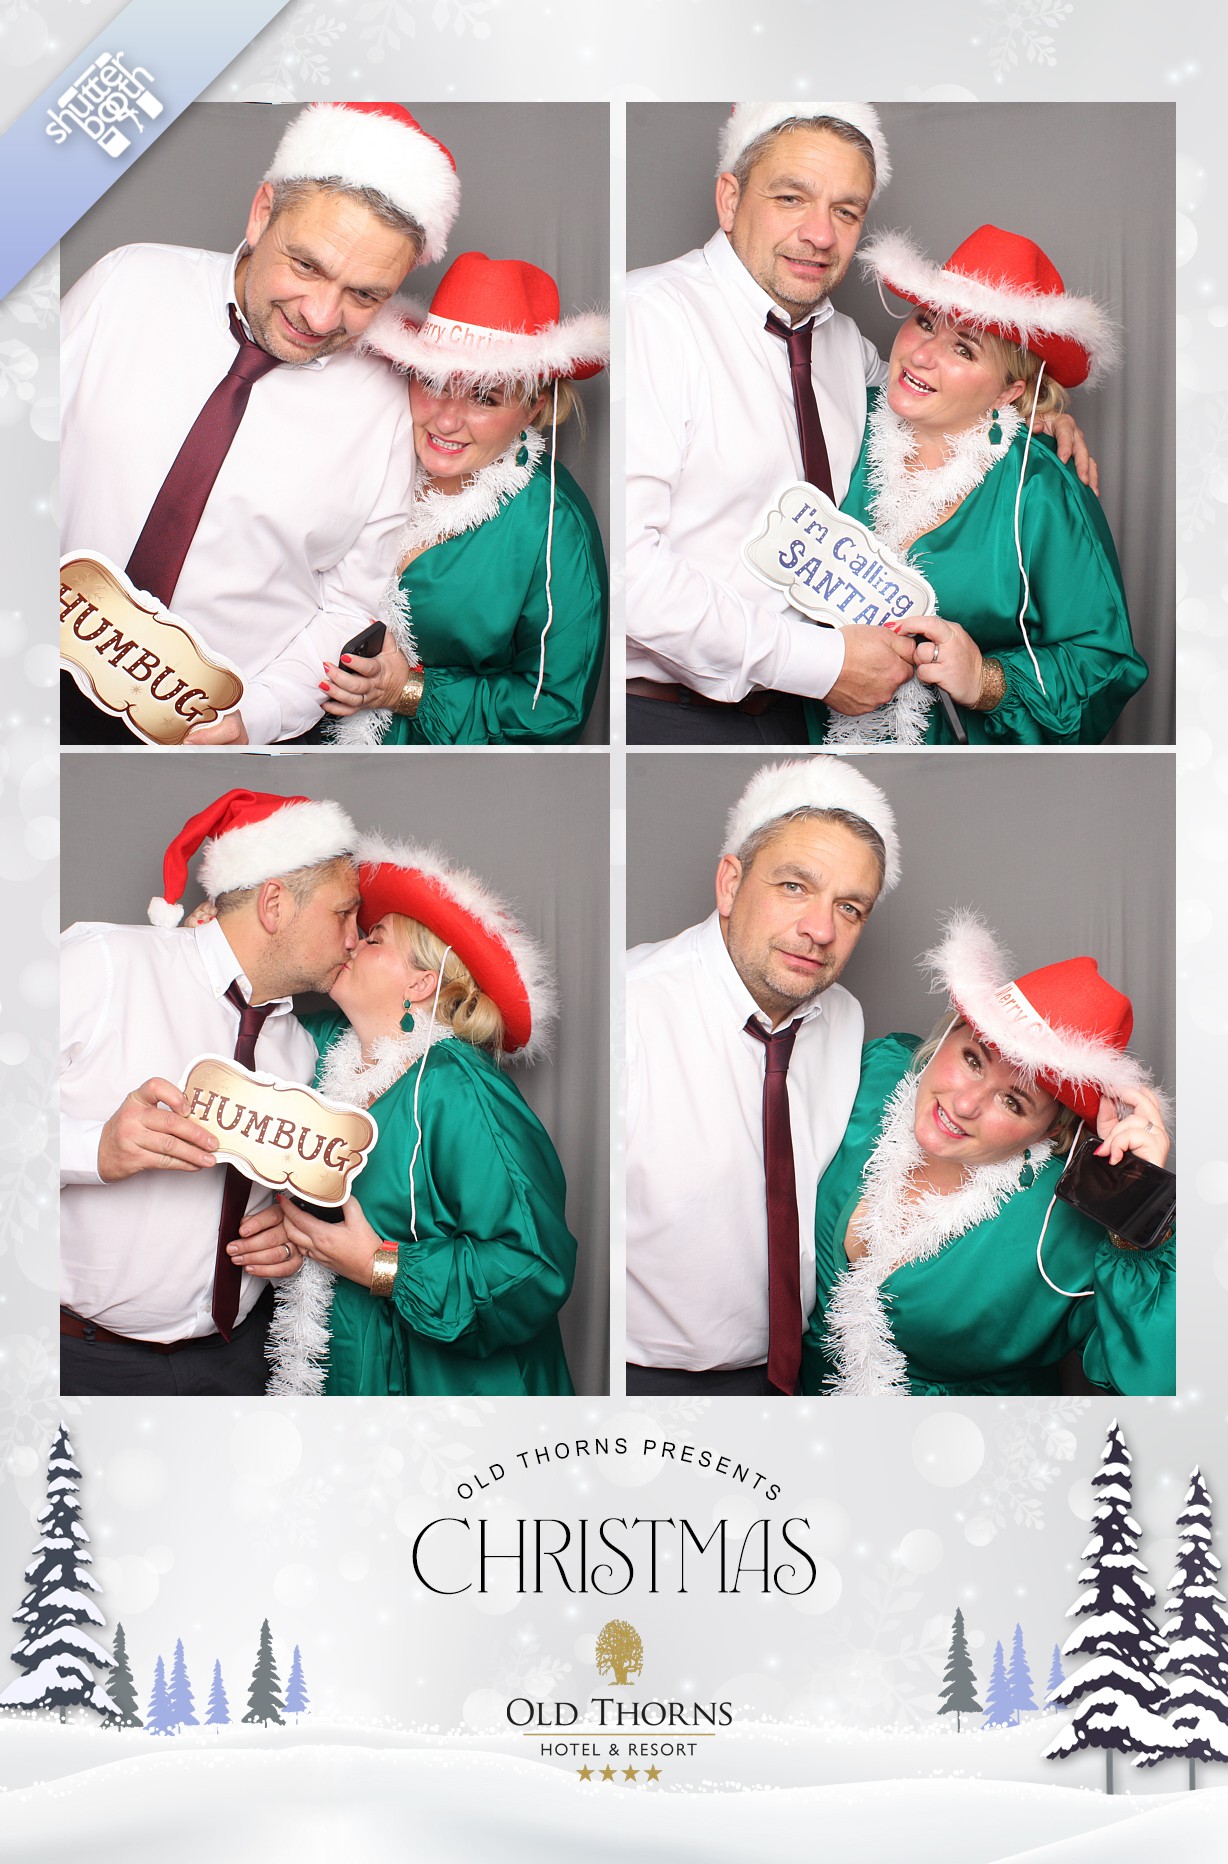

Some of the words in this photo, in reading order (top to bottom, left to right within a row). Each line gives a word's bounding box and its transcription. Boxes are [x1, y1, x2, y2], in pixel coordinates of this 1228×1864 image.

[791, 502, 829, 544] I'm
[832, 536, 914, 618] Calling
[60, 582, 209, 722] HUMBUG
[190, 1087, 350, 1172] HUMBUG
